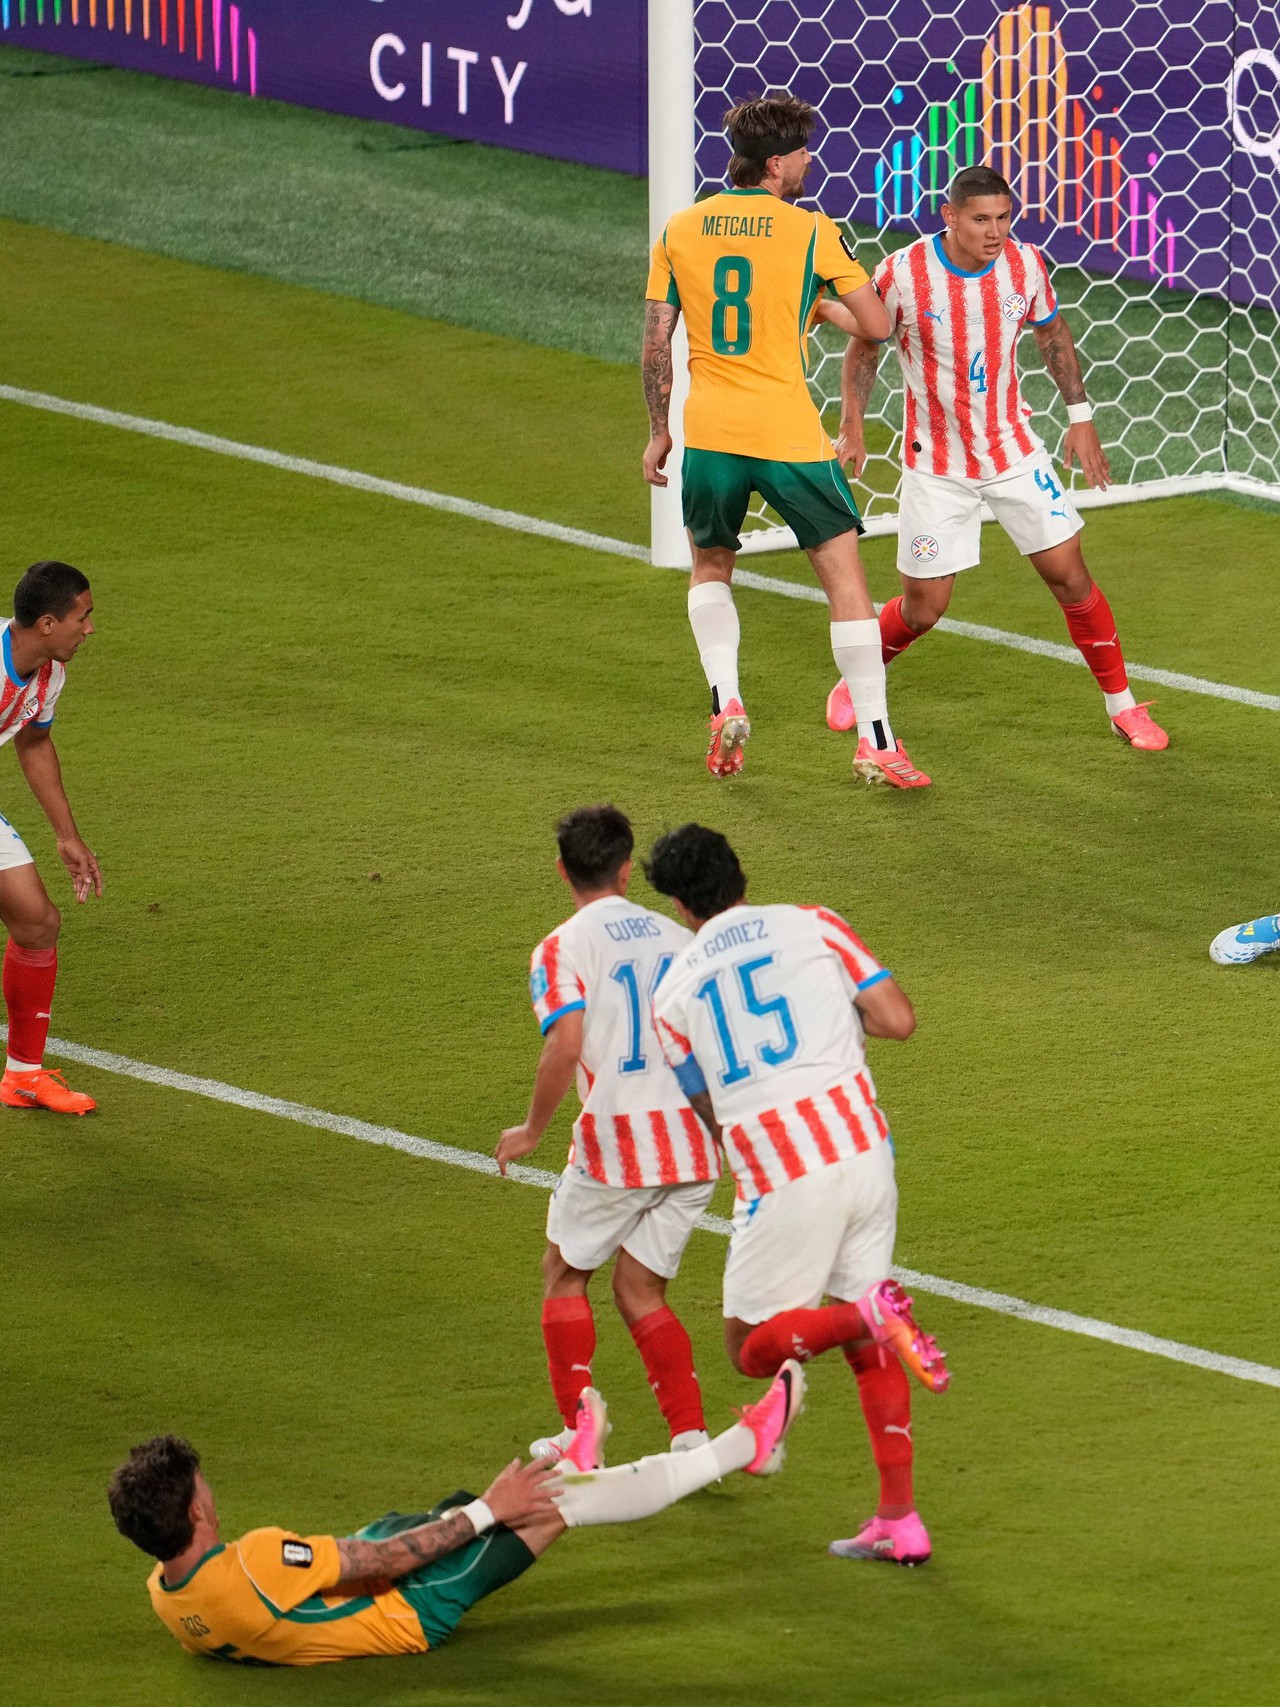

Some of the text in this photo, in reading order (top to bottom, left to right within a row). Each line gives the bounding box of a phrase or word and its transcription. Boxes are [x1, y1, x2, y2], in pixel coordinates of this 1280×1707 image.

[369, 32, 528, 124] CITY
[701, 215, 774, 238] METCALFE
[711, 255, 753, 356] 8
[967, 350, 988, 394] 4
[1033, 468, 1062, 501] 4
[604, 916, 662, 943] CUBAS
[693, 950, 804, 1088] 15
